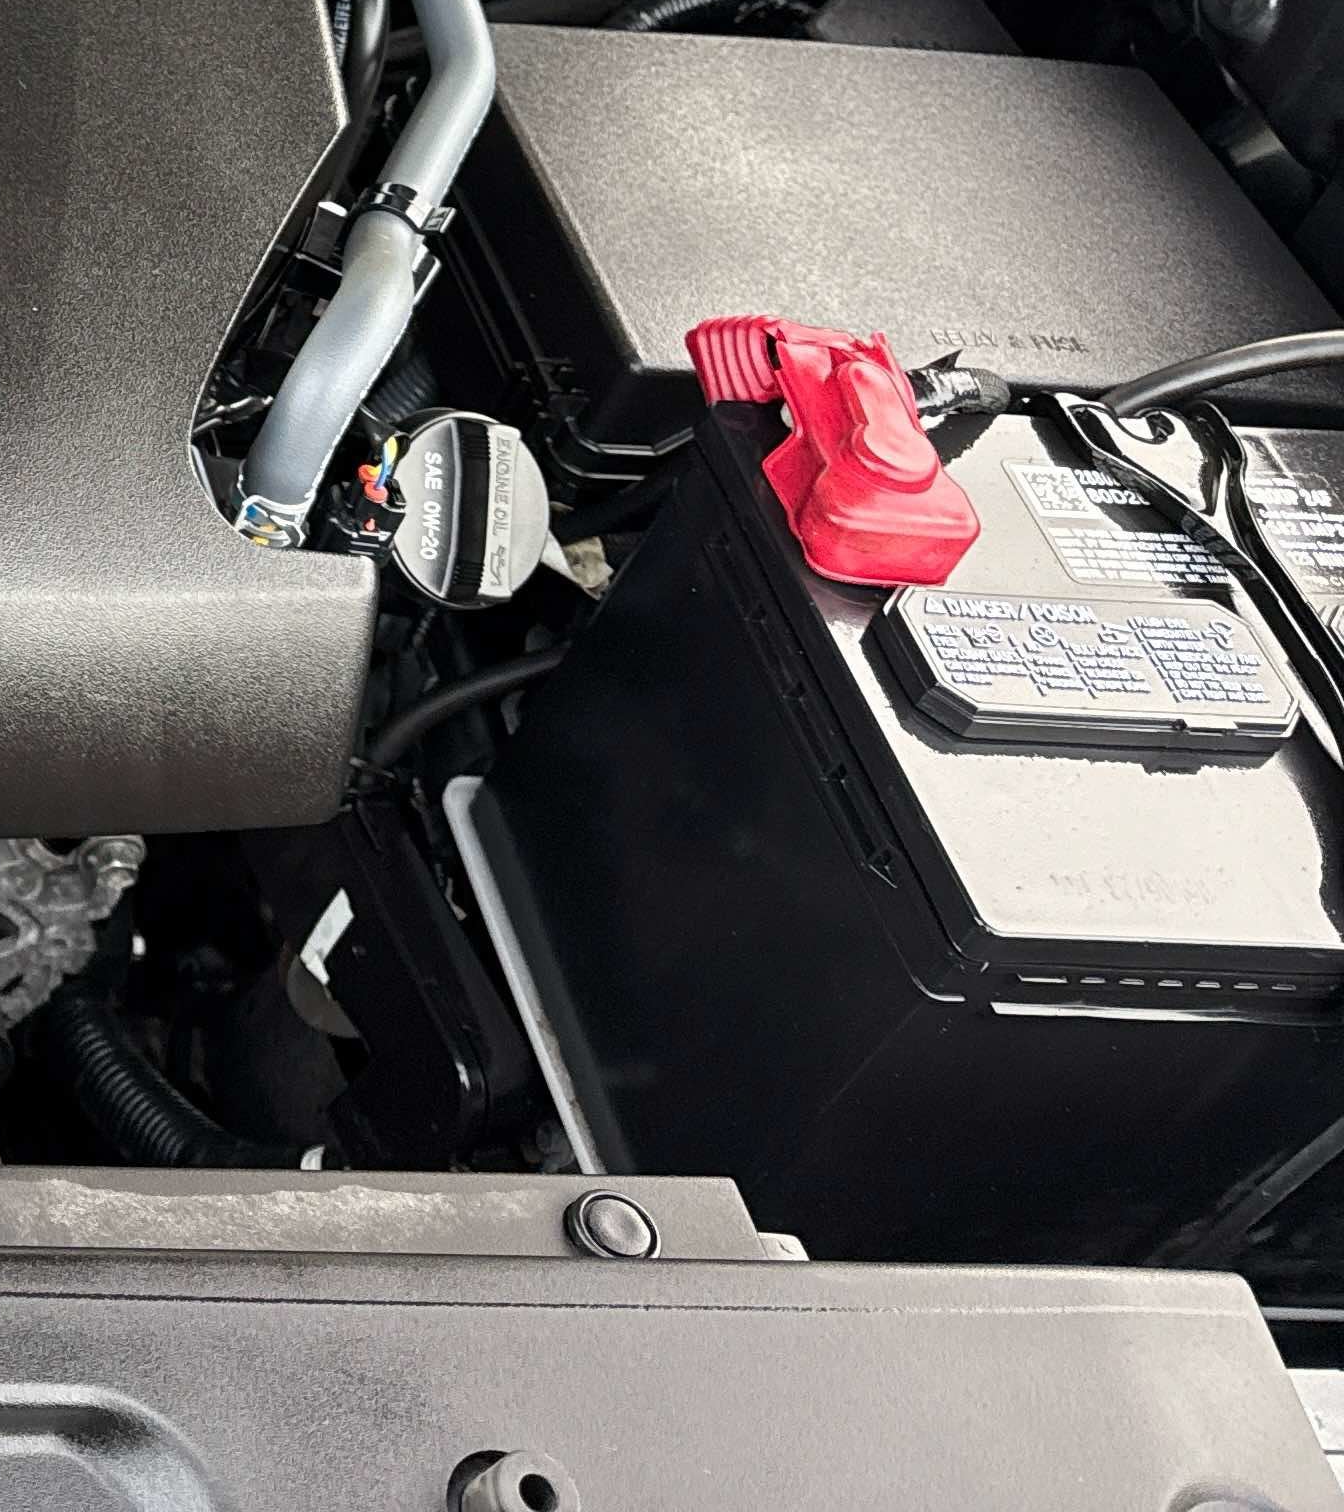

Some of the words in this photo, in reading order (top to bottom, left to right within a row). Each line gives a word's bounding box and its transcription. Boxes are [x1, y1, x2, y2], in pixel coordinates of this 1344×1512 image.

[424, 451, 443, 490] SAE
[494, 437, 512, 504] ENGINE
[420, 500, 443, 561] 0W-20
[492, 507, 510, 537] OIL
[942, 598, 1015, 621] DANGER
[1029, 603, 1098, 625] POISON
